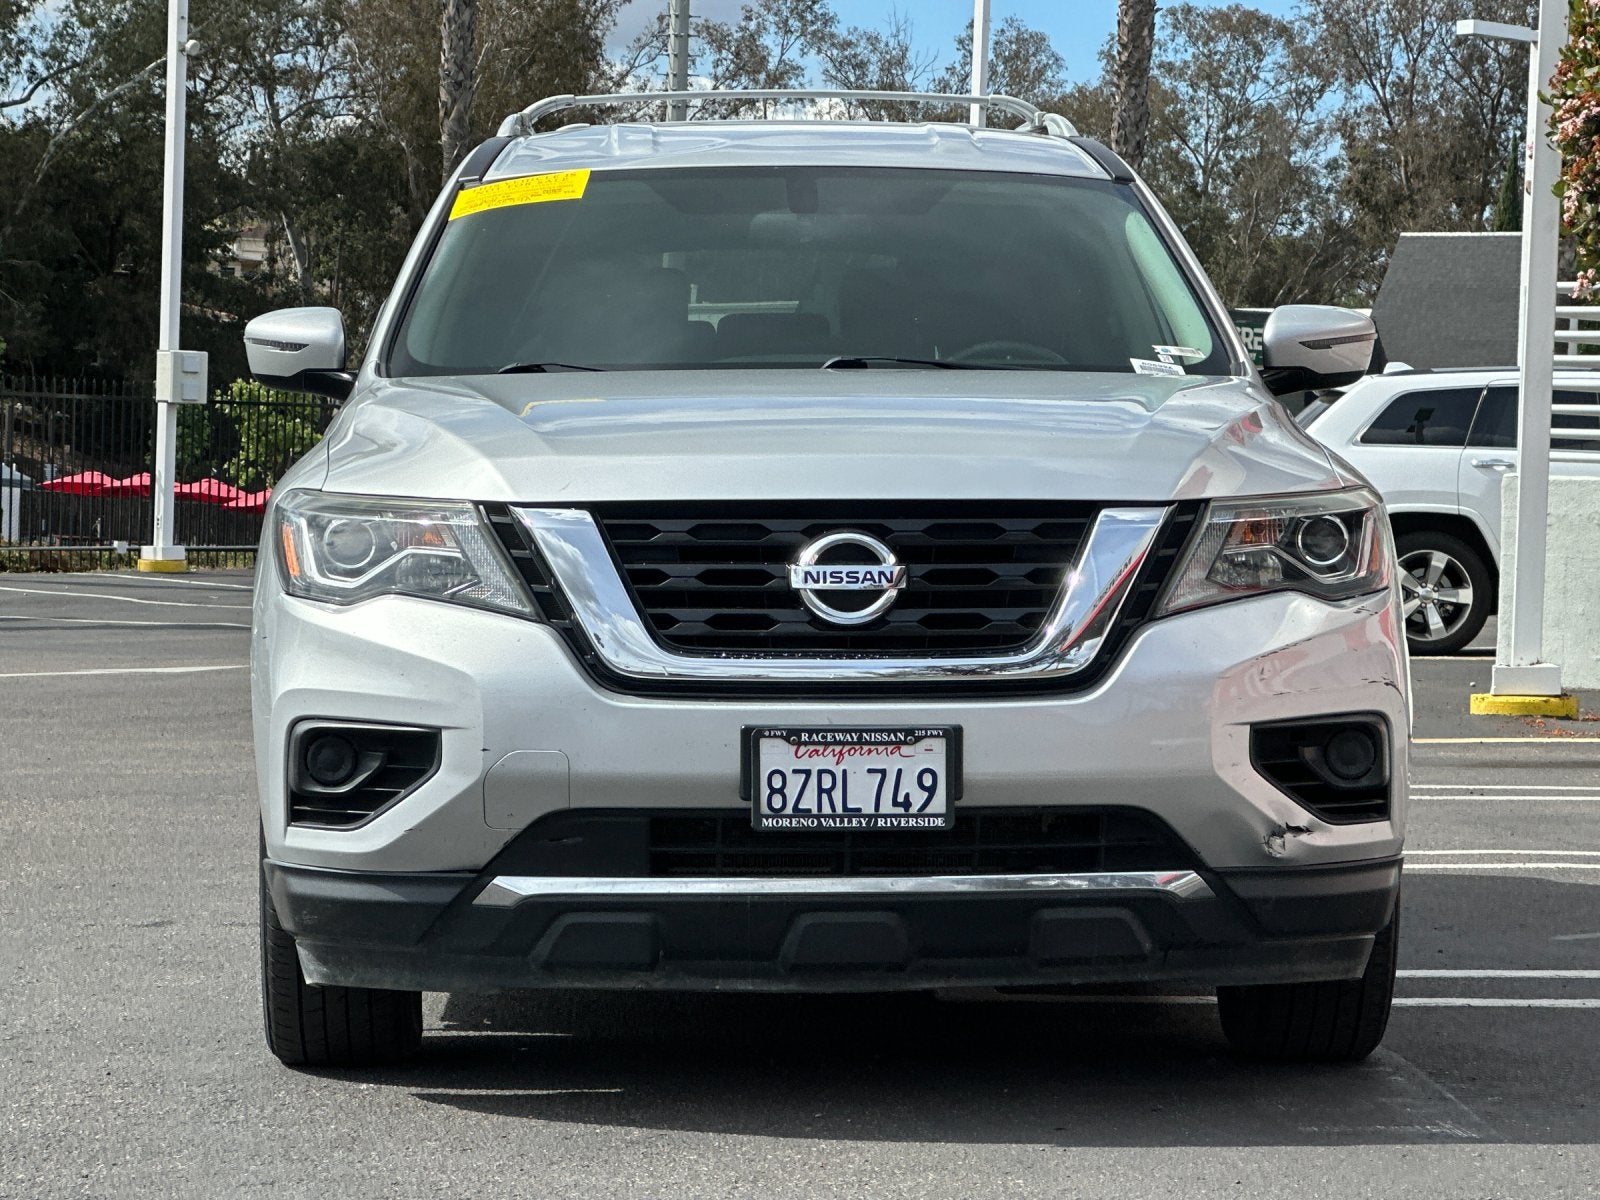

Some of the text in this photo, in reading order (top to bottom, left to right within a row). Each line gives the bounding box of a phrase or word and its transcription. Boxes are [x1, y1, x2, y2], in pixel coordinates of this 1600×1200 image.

[804, 570, 893, 585] NISSAN
[800, 732, 905, 742] RACEWAY NISSAN
[914, 728, 944, 737] 215 FWY
[794, 744, 915, 766] California
[766, 767, 938, 814] 8ZRL749
[762, 817, 818, 827] MORENO
[821, 817, 868, 827] VALLEY
[877, 817, 945, 827] RIVERSIDE
